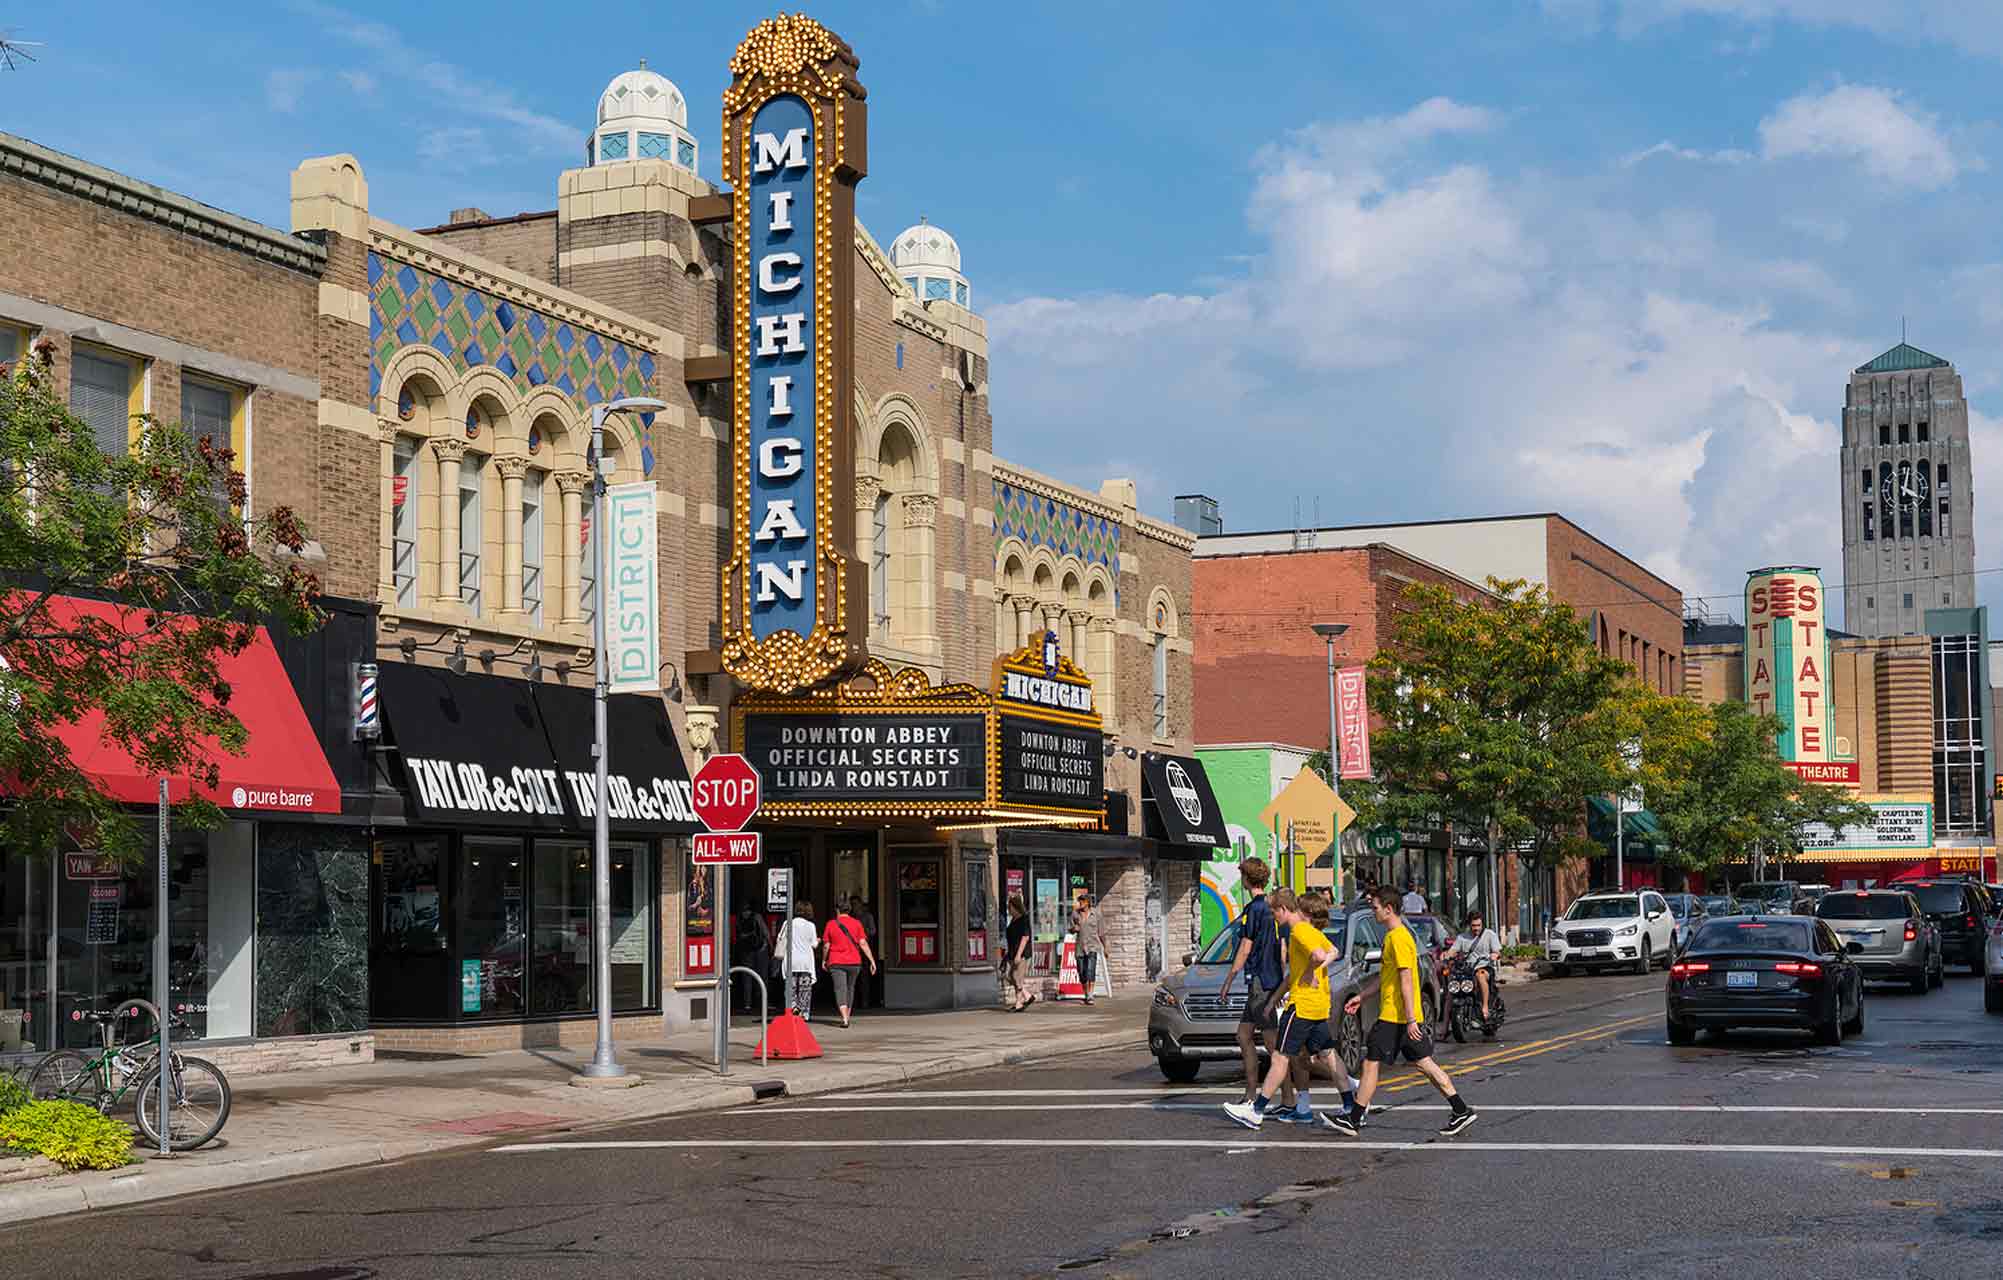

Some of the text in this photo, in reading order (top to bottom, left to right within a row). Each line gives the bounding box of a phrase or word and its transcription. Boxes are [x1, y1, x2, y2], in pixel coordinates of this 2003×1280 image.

[754, 128, 809, 603] MICHIGAN
[619, 503, 646, 672] DISTRICT
[1752, 588, 1771, 722] STAT
[1798, 586, 1821, 752] STATE
[1008, 672, 1091, 711] MICHIGAN
[1343, 678, 1362, 769] DISTRICT
[781, 728, 951, 744] DOWNTON ABBEY
[1021, 731, 1087, 755] DOWNTON ABBEY
[769, 749, 960, 765] OFFICIAL SECRETS
[1021, 752, 1093, 776] OFFICIAL SECRETS
[776, 770, 949, 787] LINDA RONSTADT
[1800, 766, 1849, 778] THEATRE
[696, 779, 754, 807] STOP
[1024, 773, 1090, 796] LINDA RONSTADT
[248, 788, 312, 807] pure barre
[1376, 836, 1395, 848] UP
